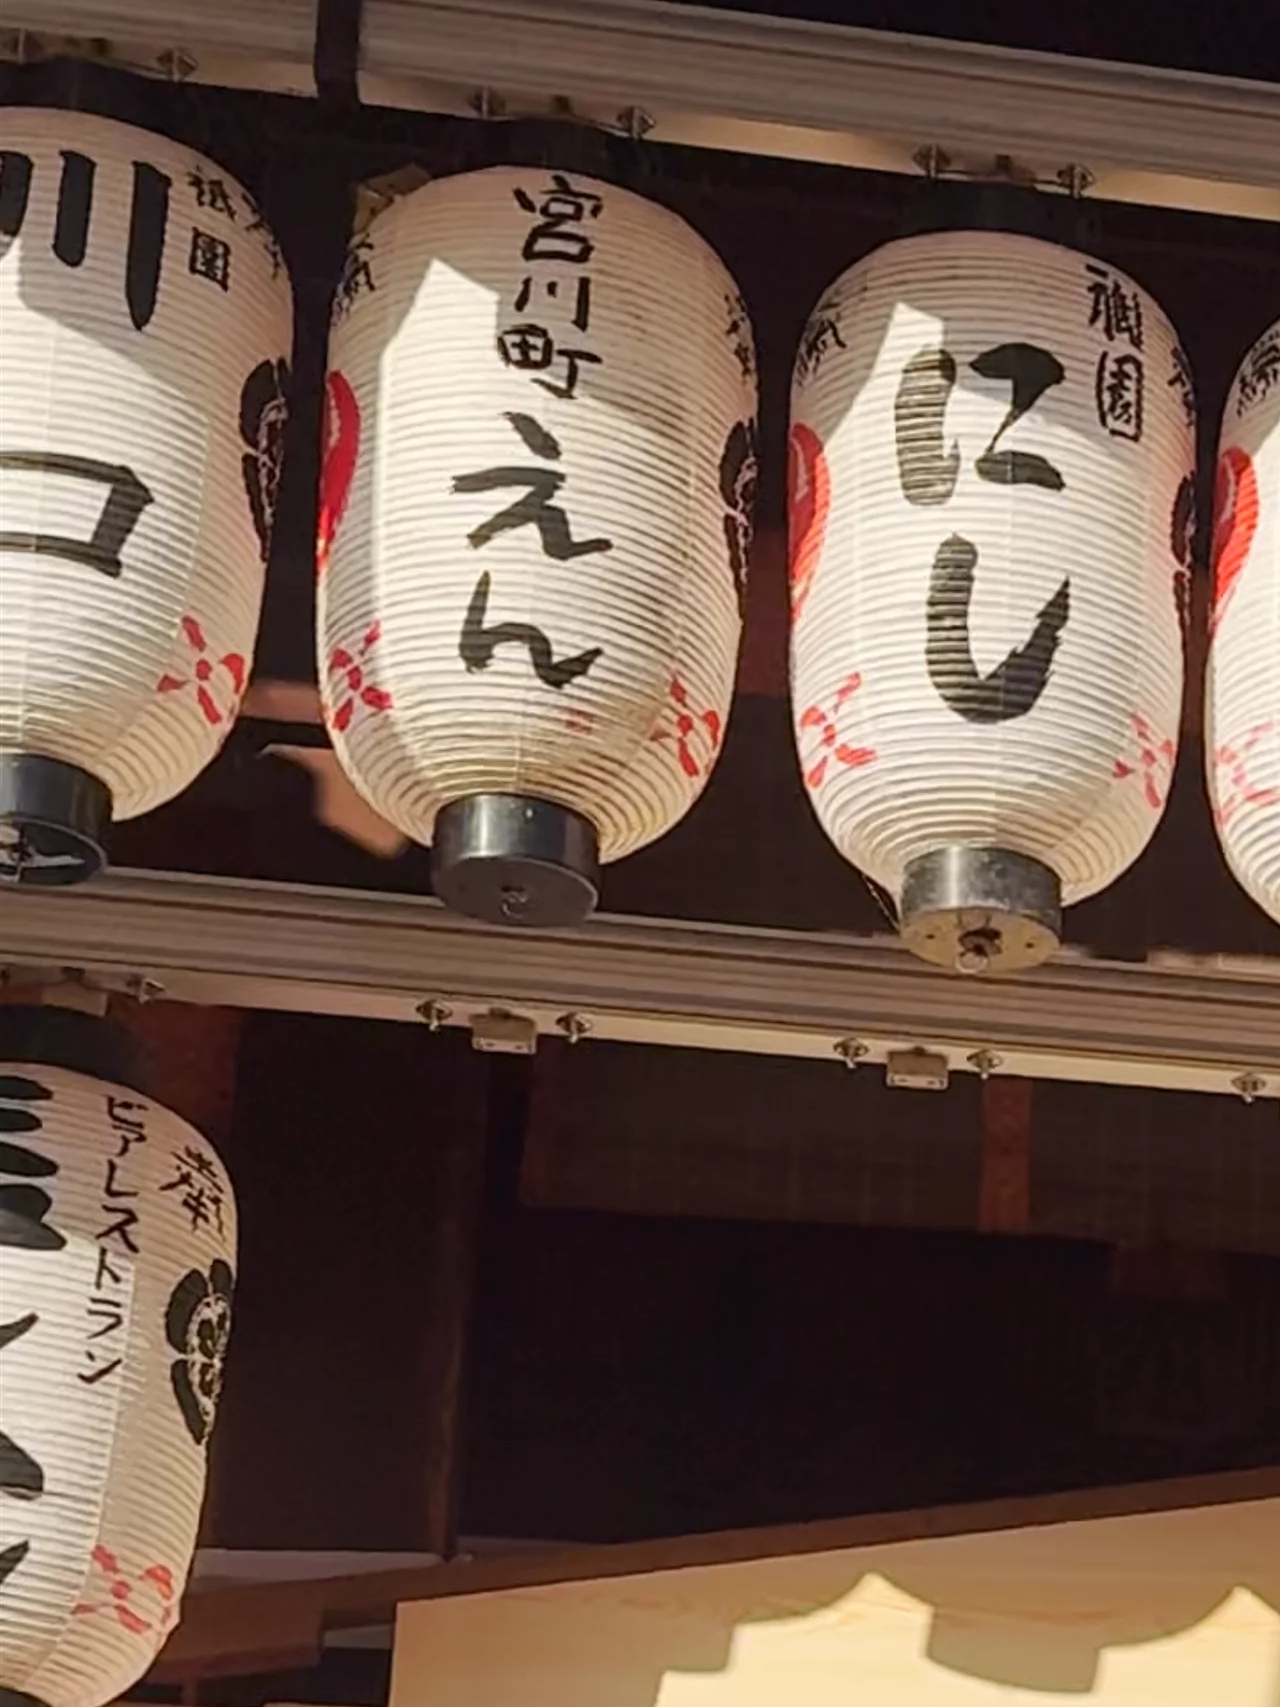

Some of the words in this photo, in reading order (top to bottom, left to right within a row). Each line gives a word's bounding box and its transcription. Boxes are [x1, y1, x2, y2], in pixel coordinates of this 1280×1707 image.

[895, 343, 1070, 722] にし
[77, 1093, 148, 1385] ビアレストラン
